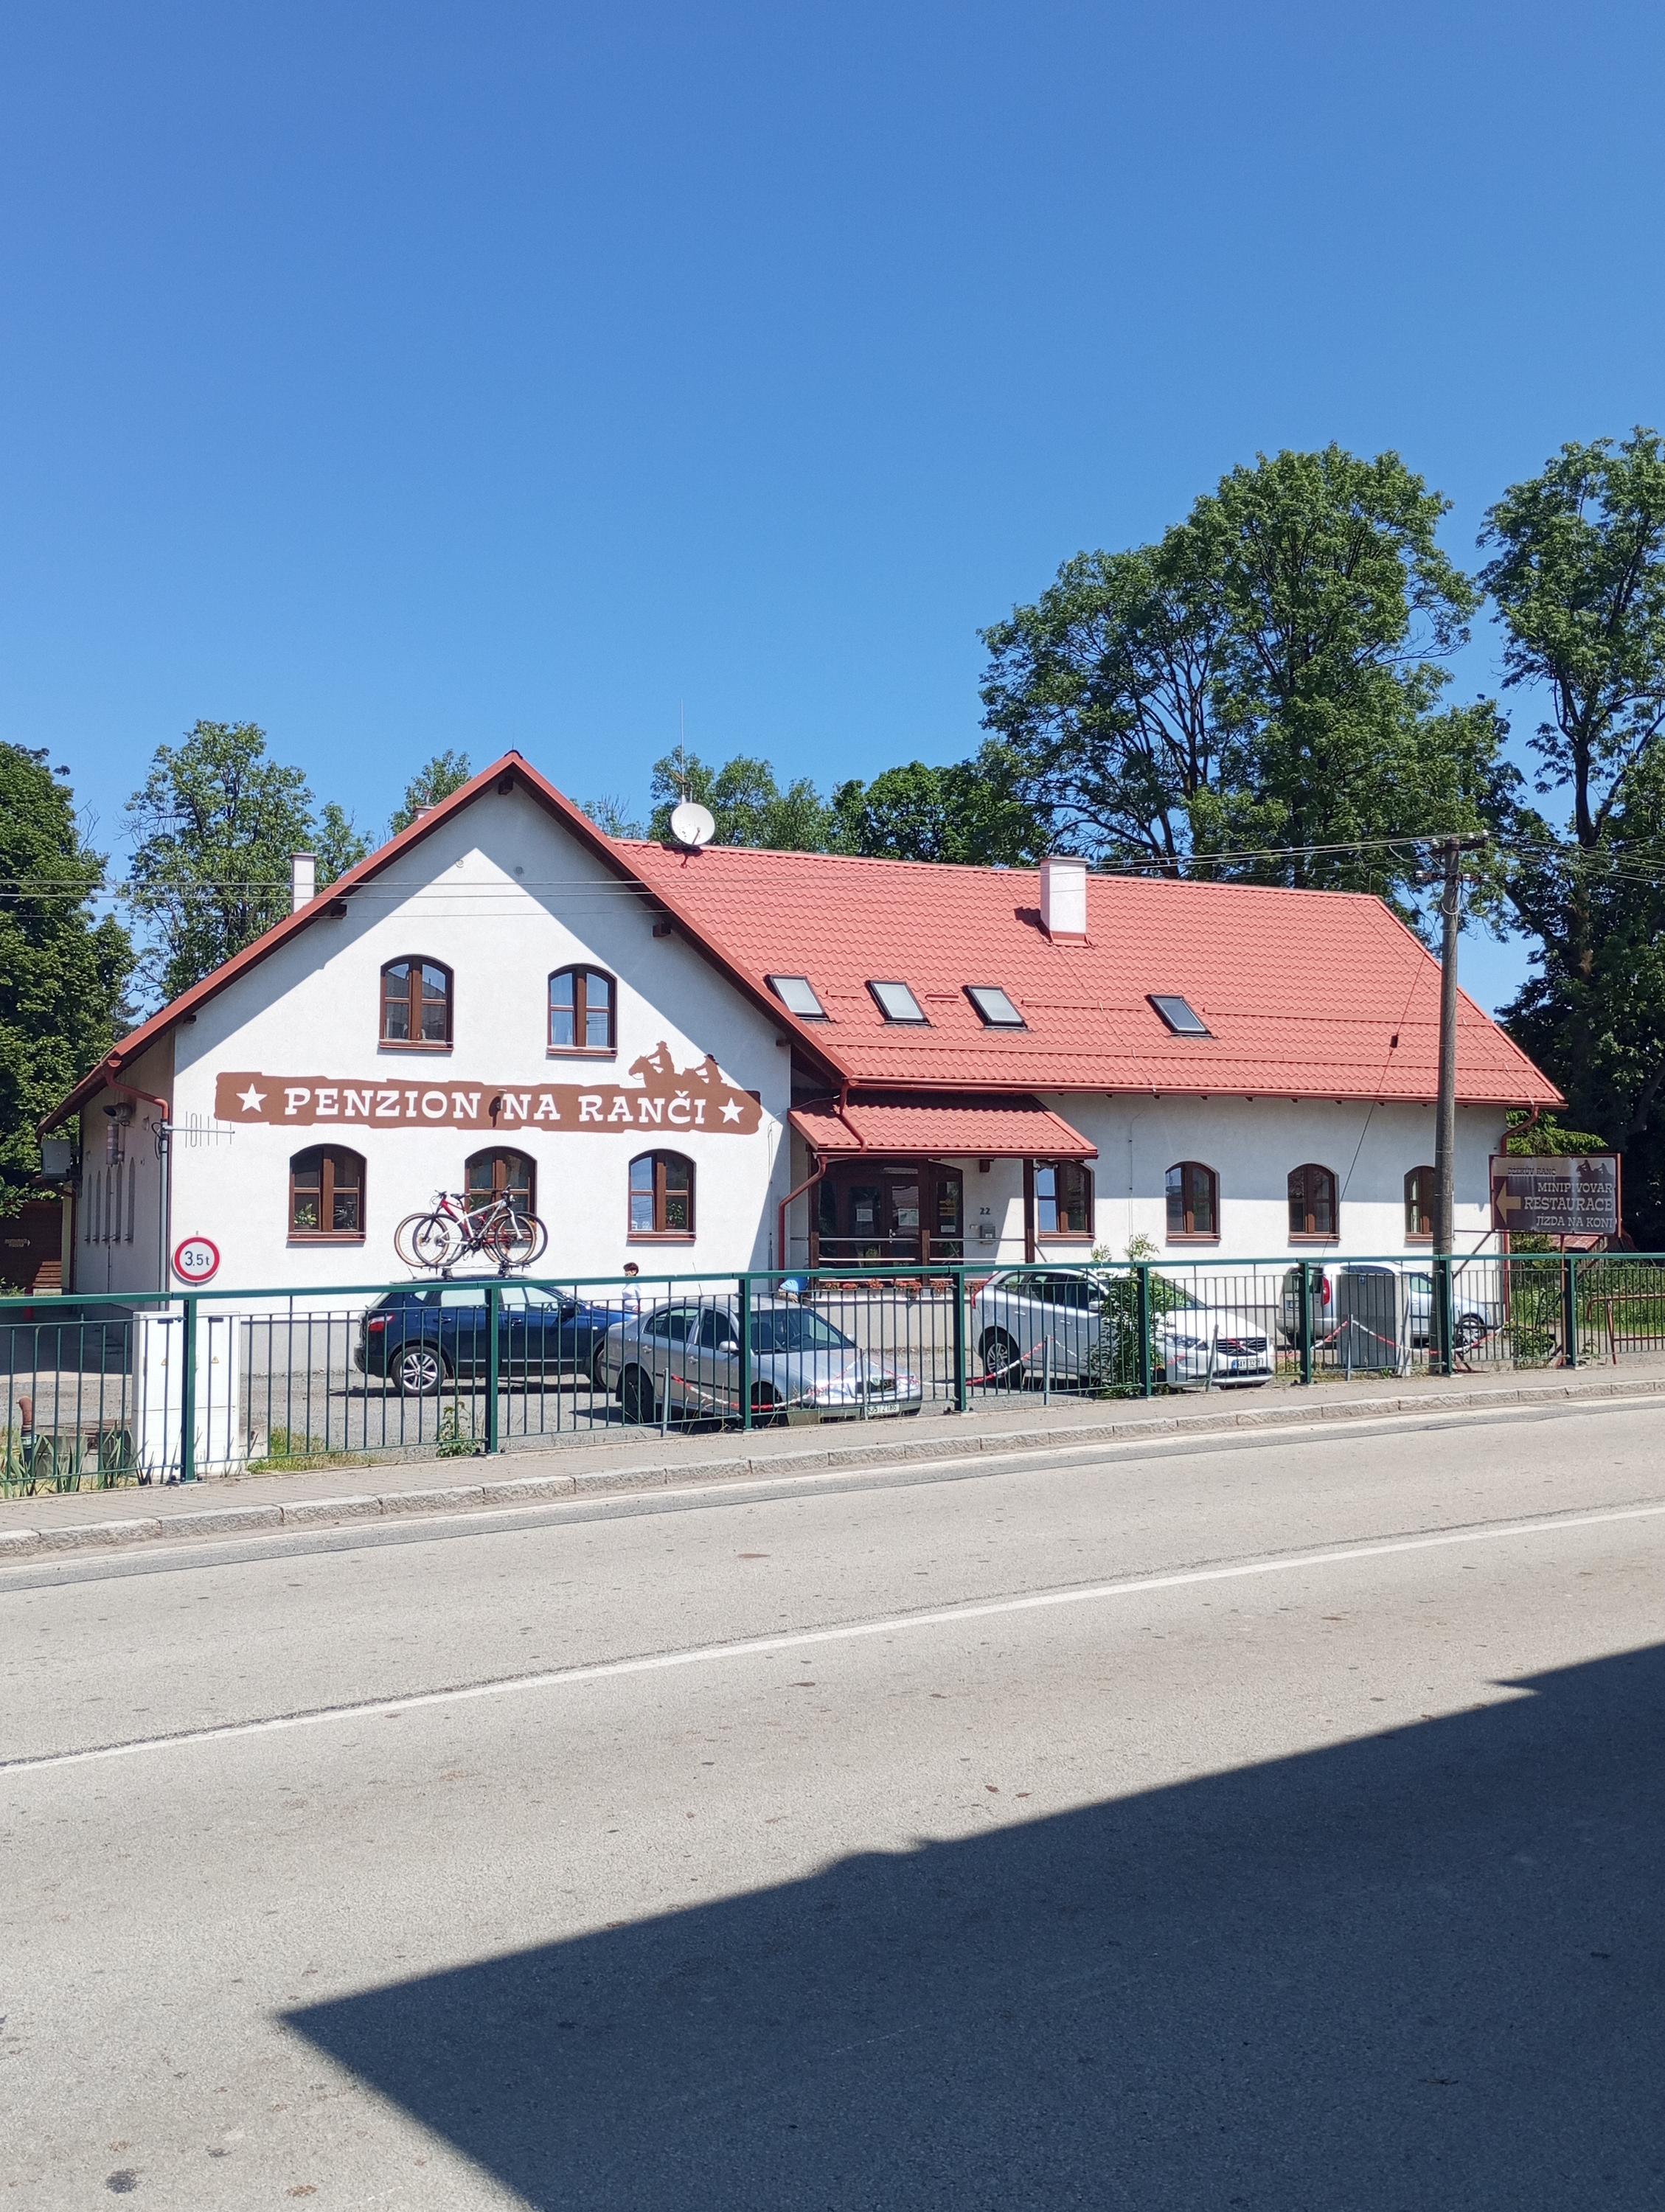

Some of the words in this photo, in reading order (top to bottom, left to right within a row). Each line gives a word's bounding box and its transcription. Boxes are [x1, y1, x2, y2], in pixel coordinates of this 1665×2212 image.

[284, 1088, 482, 1119] PENZION
[502, 1093, 561, 1120] NA
[578, 1090, 706, 1124] RANČI
[1537, 1182, 1613, 1194] MINIPIVOVAR
[980, 1207, 991, 1215] 22
[1524, 1196, 1613, 1211] RESTAURACE
[1536, 1213, 1565, 1227] JÍZDA
[1568, 1217, 1585, 1227] NA
[1586, 1217, 1613, 1228] KONI
